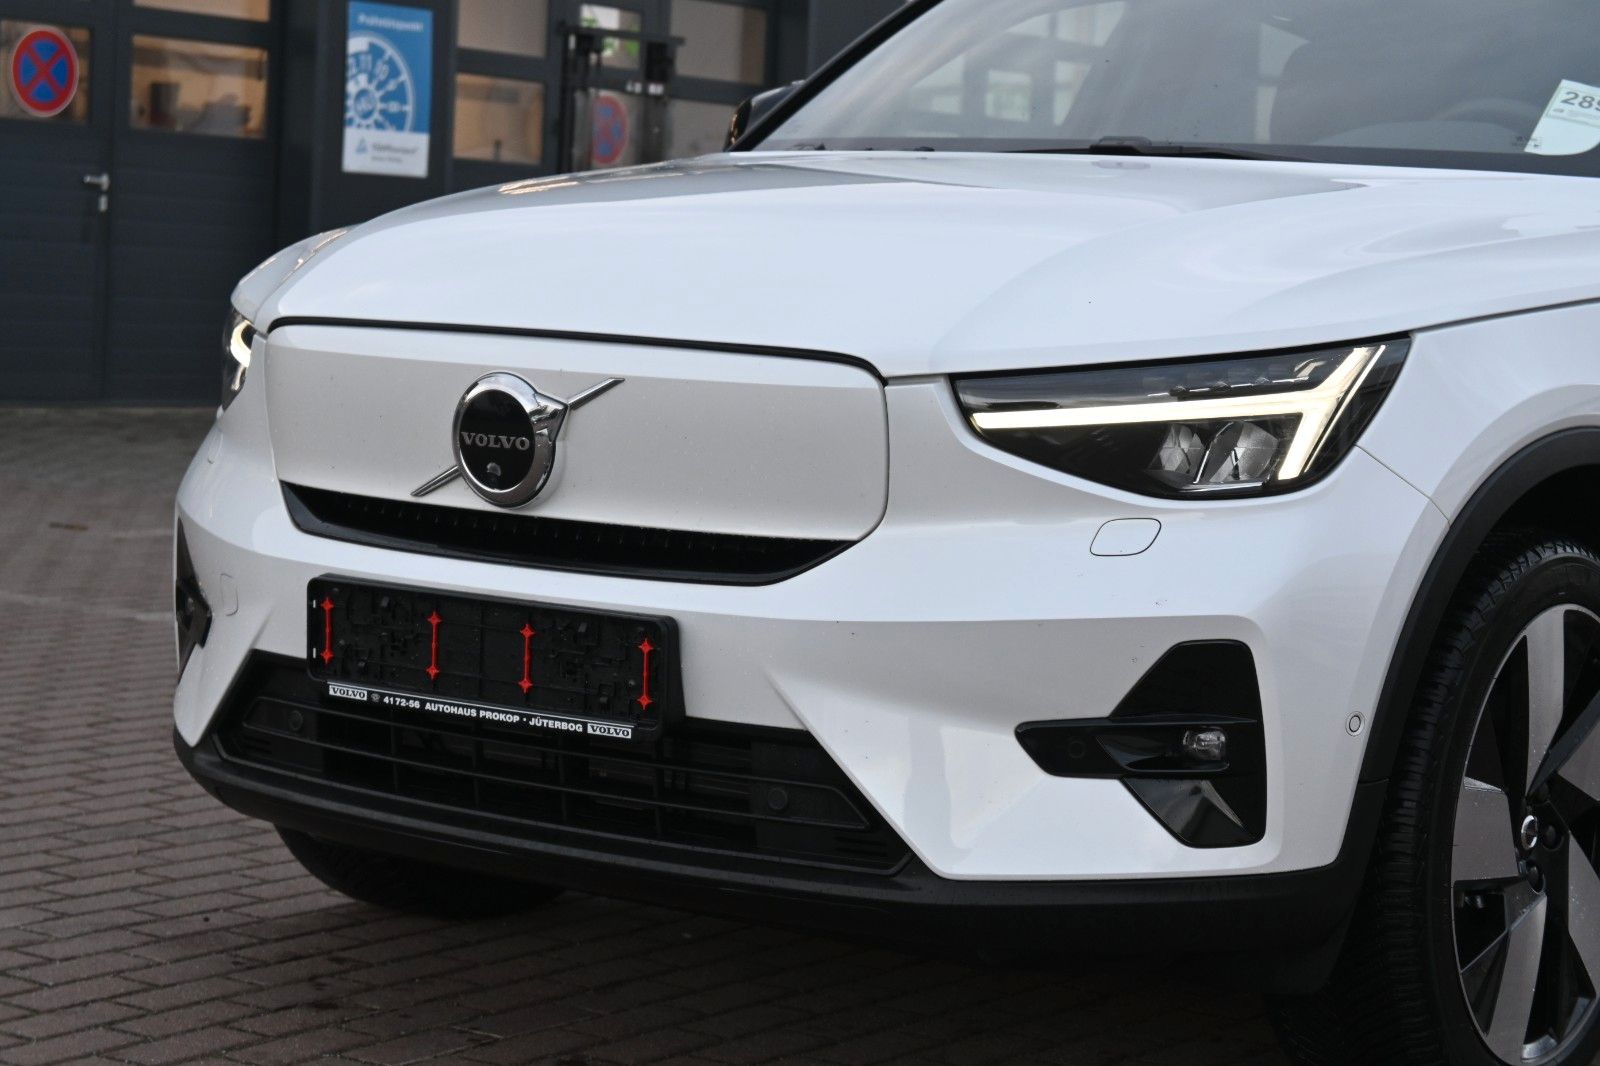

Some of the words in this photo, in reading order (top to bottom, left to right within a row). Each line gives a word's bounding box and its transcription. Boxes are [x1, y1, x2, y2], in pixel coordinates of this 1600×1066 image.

[461, 431, 530, 451] VOLVO
[332, 687, 366, 699] VOLVO
[383, 696, 420, 709] 4172-56
[425, 702, 477, 718] AUTOHAUS
[479, 709, 520, 724] PROKOP
[529, 715, 583, 732] JÜTERBOG
[590, 723, 631, 737] VOLVO
